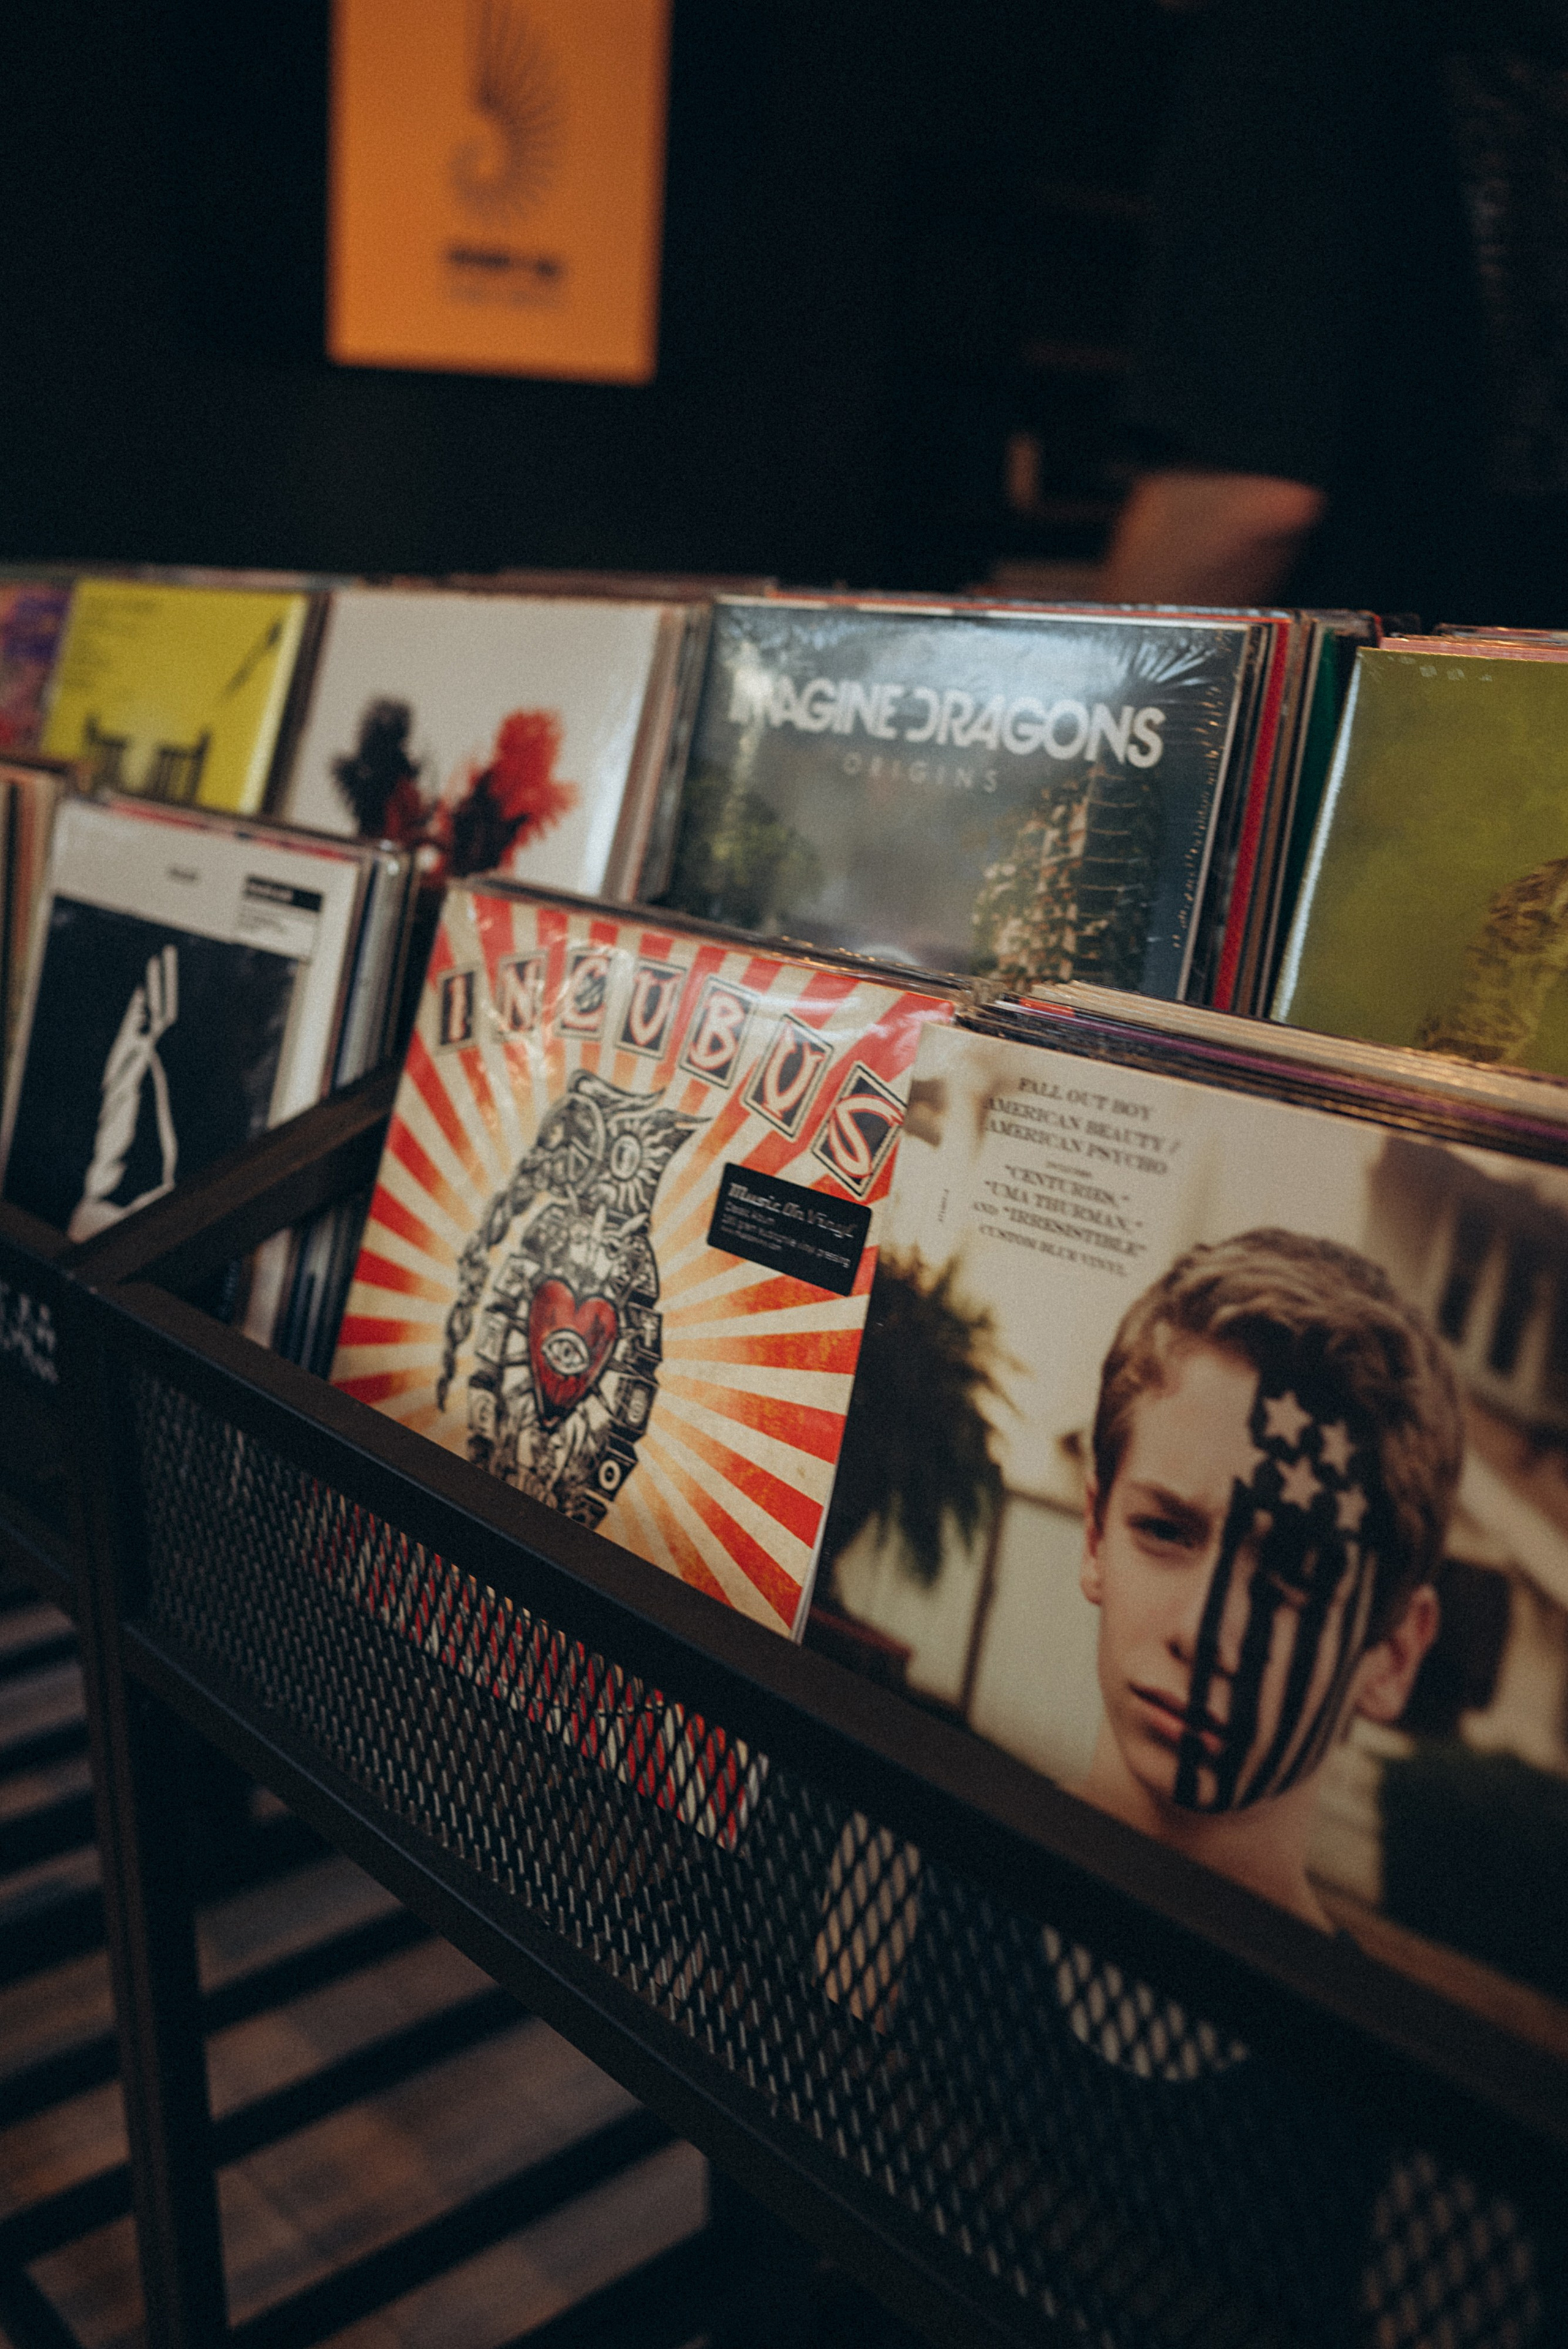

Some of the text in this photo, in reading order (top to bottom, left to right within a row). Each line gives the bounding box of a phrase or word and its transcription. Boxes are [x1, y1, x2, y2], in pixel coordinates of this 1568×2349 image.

[904, 686, 1166, 769] DRAGONS
[843, 751, 999, 793] ORIGINS
[445, 953, 906, 1181] INCUBUS
[982, 1096, 1083, 1130] AMERICAN
[1085, 1120, 1165, 1153] BEAUTY
[1018, 1077, 1154, 1121] FALL OUT BOY
[984, 1119, 1084, 1153] AMERICAN
[1086, 1142, 1168, 1175] PSYCHO
